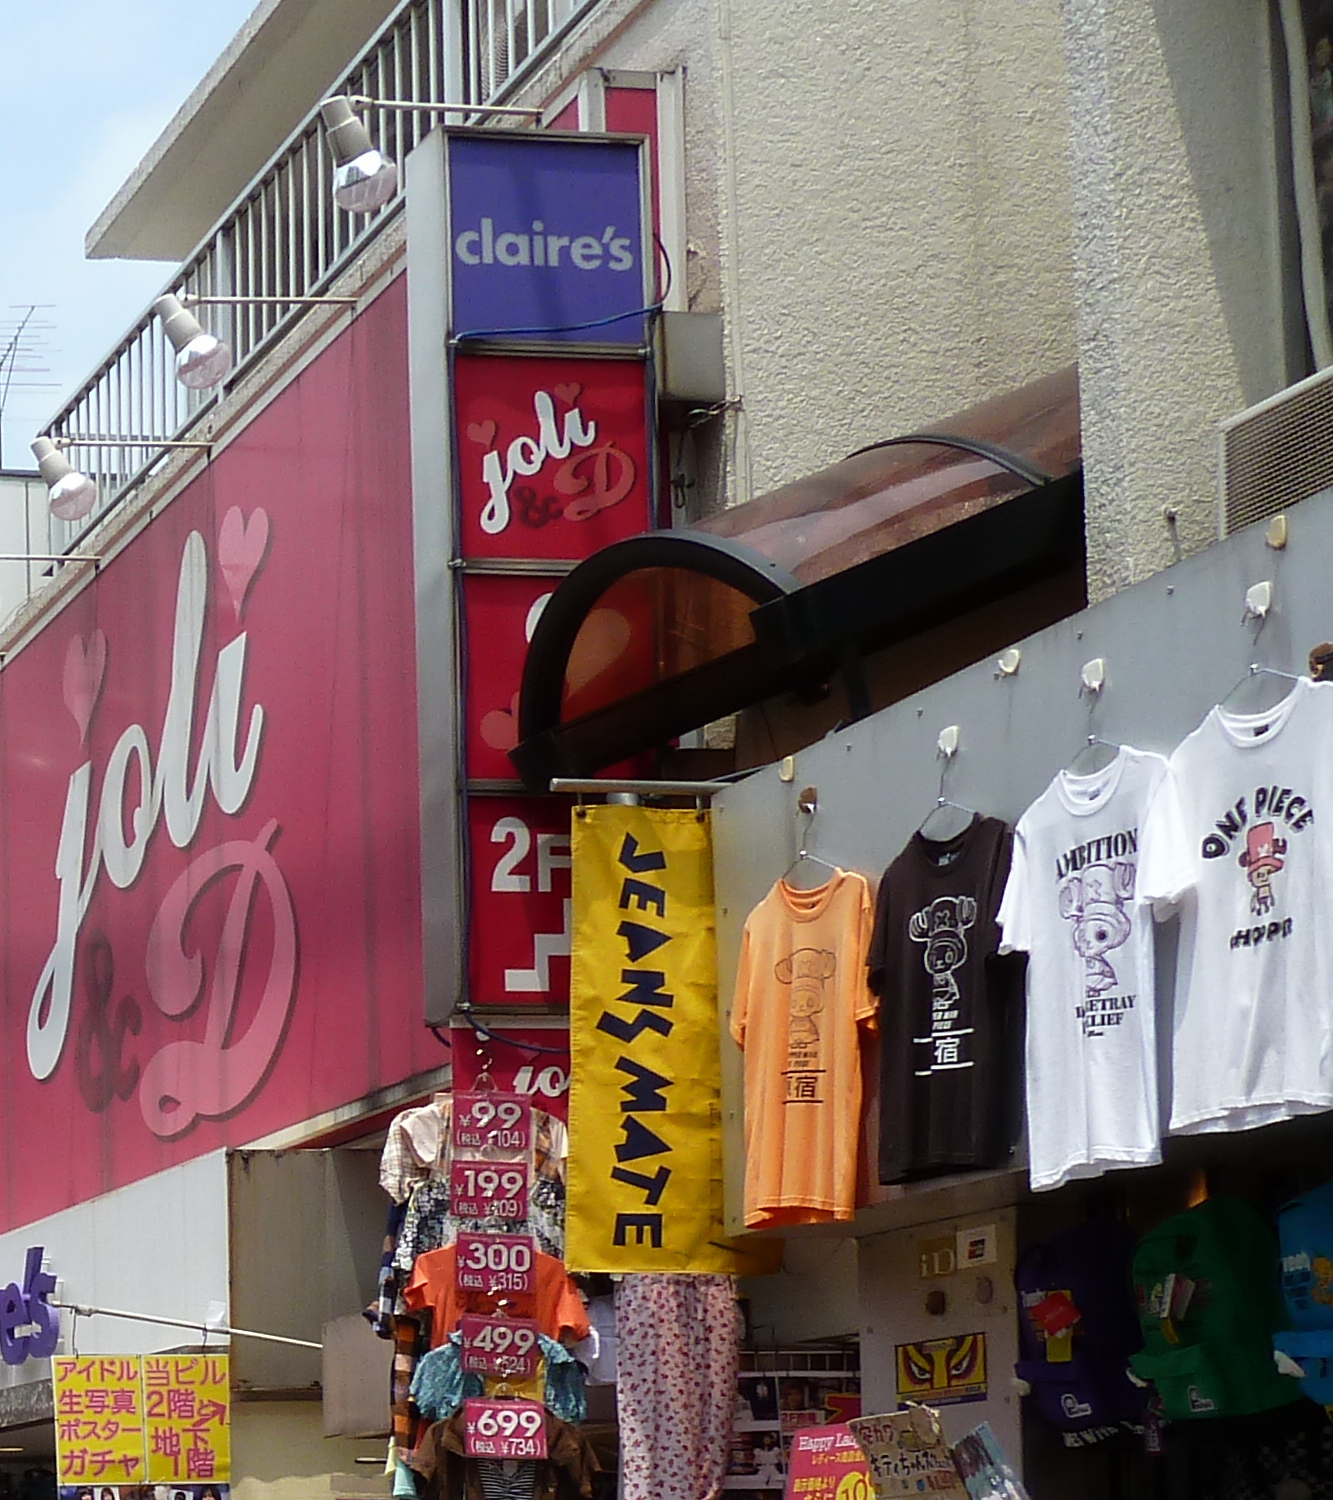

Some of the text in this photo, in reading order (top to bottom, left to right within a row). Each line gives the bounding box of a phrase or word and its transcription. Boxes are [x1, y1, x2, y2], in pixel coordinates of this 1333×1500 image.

[455, 217, 633, 271] claire's
[480, 391, 596, 534] joli
[26, 530, 264, 1080] joli
[1254, 785, 1314, 833] PIECE
[597, 831, 675, 1248] JEANS MATE
[459, 1101, 522, 1129] ¥99
[456, 1170, 523, 1198] ¥199
[457, 1243, 531, 1273] ¥300
[464, 1325, 536, 1356] ¥499
[57, 1360, 138, 1383] アイドル
[59, 1389, 136, 1414] 生写真
[60, 1419, 141, 1441] ポスター
[467, 1409, 541, 1438] ¥699
[502, 1438, 541, 1457] ¥734)
[62, 1448, 139, 1477] ガチャ
